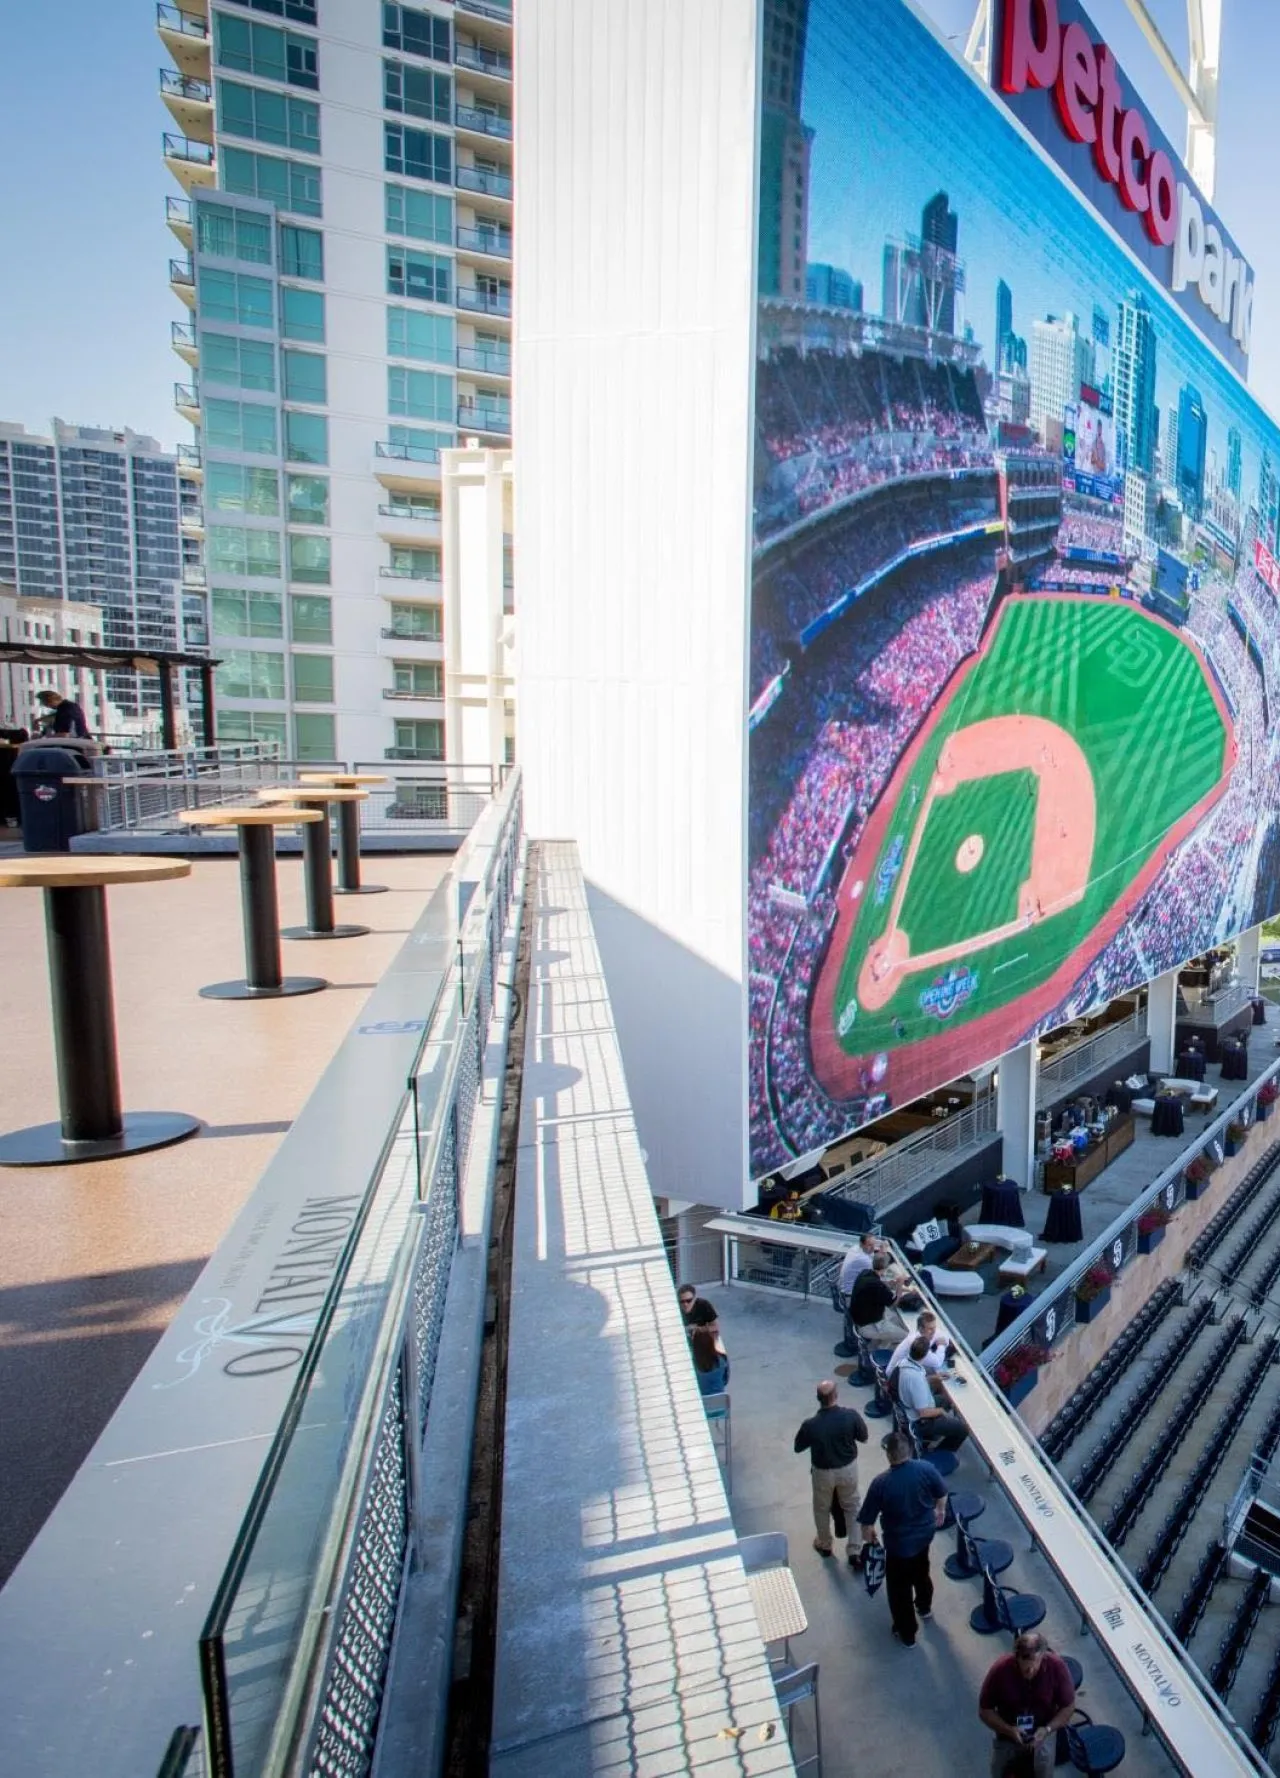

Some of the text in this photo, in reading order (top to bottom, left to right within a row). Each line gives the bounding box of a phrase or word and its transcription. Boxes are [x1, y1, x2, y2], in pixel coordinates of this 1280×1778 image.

[1002, 0, 1254, 352] petco park
[222, 1194, 361, 1378] MONTALVO
[1131, 1642, 1182, 1708] MONTALVO
